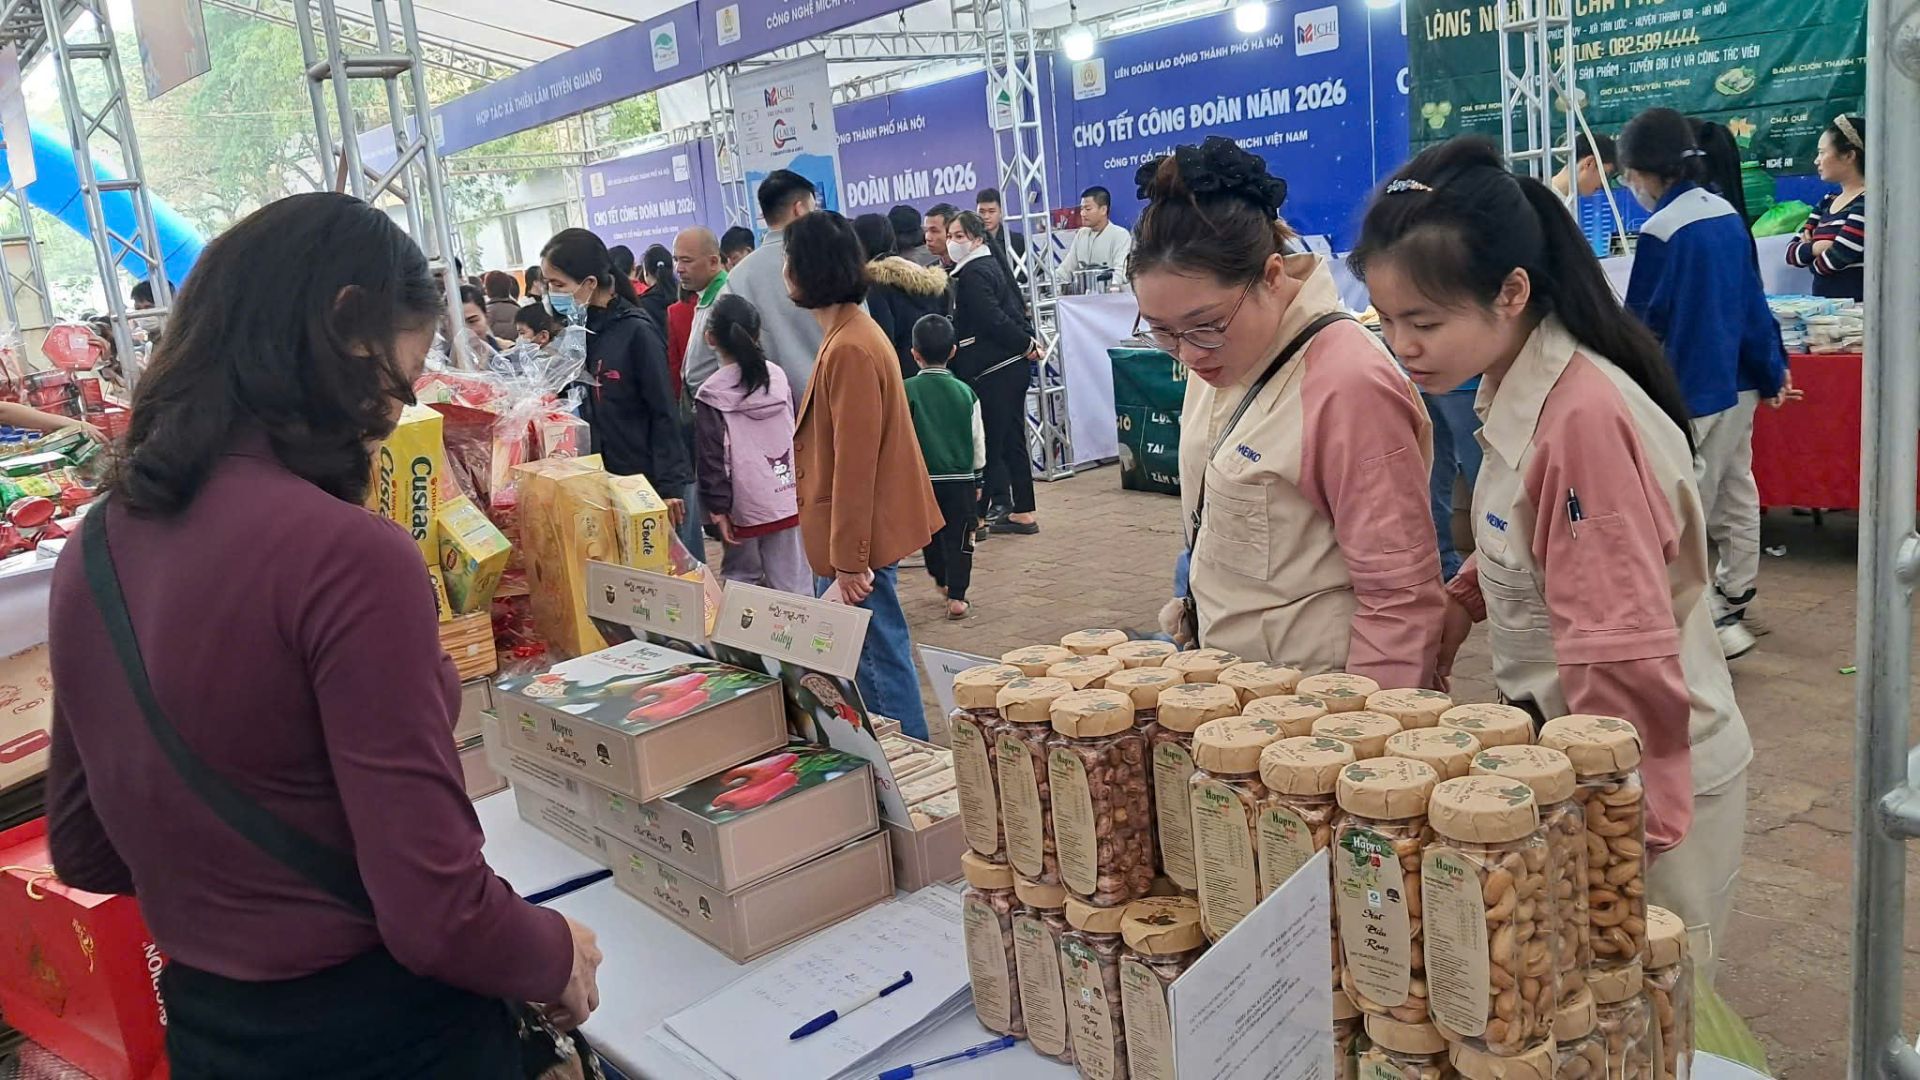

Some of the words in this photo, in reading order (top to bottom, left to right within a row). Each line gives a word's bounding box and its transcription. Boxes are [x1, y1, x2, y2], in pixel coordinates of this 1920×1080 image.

[766, 10, 790, 29] CÔNG
[791, 0, 814, 20] NGHỆ
[1713, 2, 1727, 15] NỘI
[1297, 20, 1337, 45] MICHI
[1425, 8, 1471, 41] LÀNG
[1114, 66, 1130, 79] LIÊN
[1131, 61, 1154, 76] ĐOÀN
[1156, 59, 1171, 71] LAO
[1173, 52, 1198, 69] ĐỘNG
[1199, 44, 1229, 61] THÀNH
[1230, 37, 1249, 55] PHỐ
[1251, 36, 1265, 50] HÀ
[1267, 34, 1284, 48] NỘI
[1723, 46, 1739, 61] TÁC
[1742, 44, 1760, 58] VIÊN
[491, 104, 504, 120] TÁC
[573, 67, 603, 90] QUANG
[1073, 121, 1104, 148] CHỢ
[1107, 109, 1135, 142] TẾT
[1138, 106, 1185, 139] CÔNG
[1190, 95, 1243, 128] ĐOÀN
[1247, 88, 1290, 120] NĂM
[1295, 79, 1347, 112] 2026
[852, 124, 878, 143] THÀNH
[879, 119, 895, 138] PHỐ
[897, 118, 909, 135] HÀ
[910, 113, 926, 133] NỘI
[1104, 156, 1128, 169] CÔNG
[1129, 154, 1138, 166] TY
[1234, 136, 1263, 149] MICHI
[1264, 131, 1284, 147] VIỆT
[1285, 129, 1308, 144] NAM
[847, 173, 890, 208] ĐOÀN
[893, 167, 930, 201] NĂM
[934, 162, 977, 195] 2026
[607, 205, 619, 224] TẾT
[620, 204, 639, 222] CÔNG
[1236, 443, 1262, 464] MEIKO
[380, 446, 394, 518] Custa
[411, 456, 432, 541] Custas
[1486, 511, 1508, 533] MEIKO
[632, 604, 651, 621] Hapro
[770, 631, 793, 651] Hapro
[550, 717, 574, 737] Hapro
[957, 724, 974, 737] Hapro
[1003, 740, 1021, 754] Hapro
[1163, 747, 1182, 761] Hapro
[1056, 753, 1075, 768] Hapro
[1205, 789, 1230, 804] Hapro
[1272, 812, 1297, 828] Hapro
[1353, 837, 1382, 853] Hapro
[1435, 857, 1464, 877] Hapro
[971, 904, 989, 917] Hapro
[1022, 922, 1042, 936] Hapro
[1130, 966, 1151, 982] Hapro
